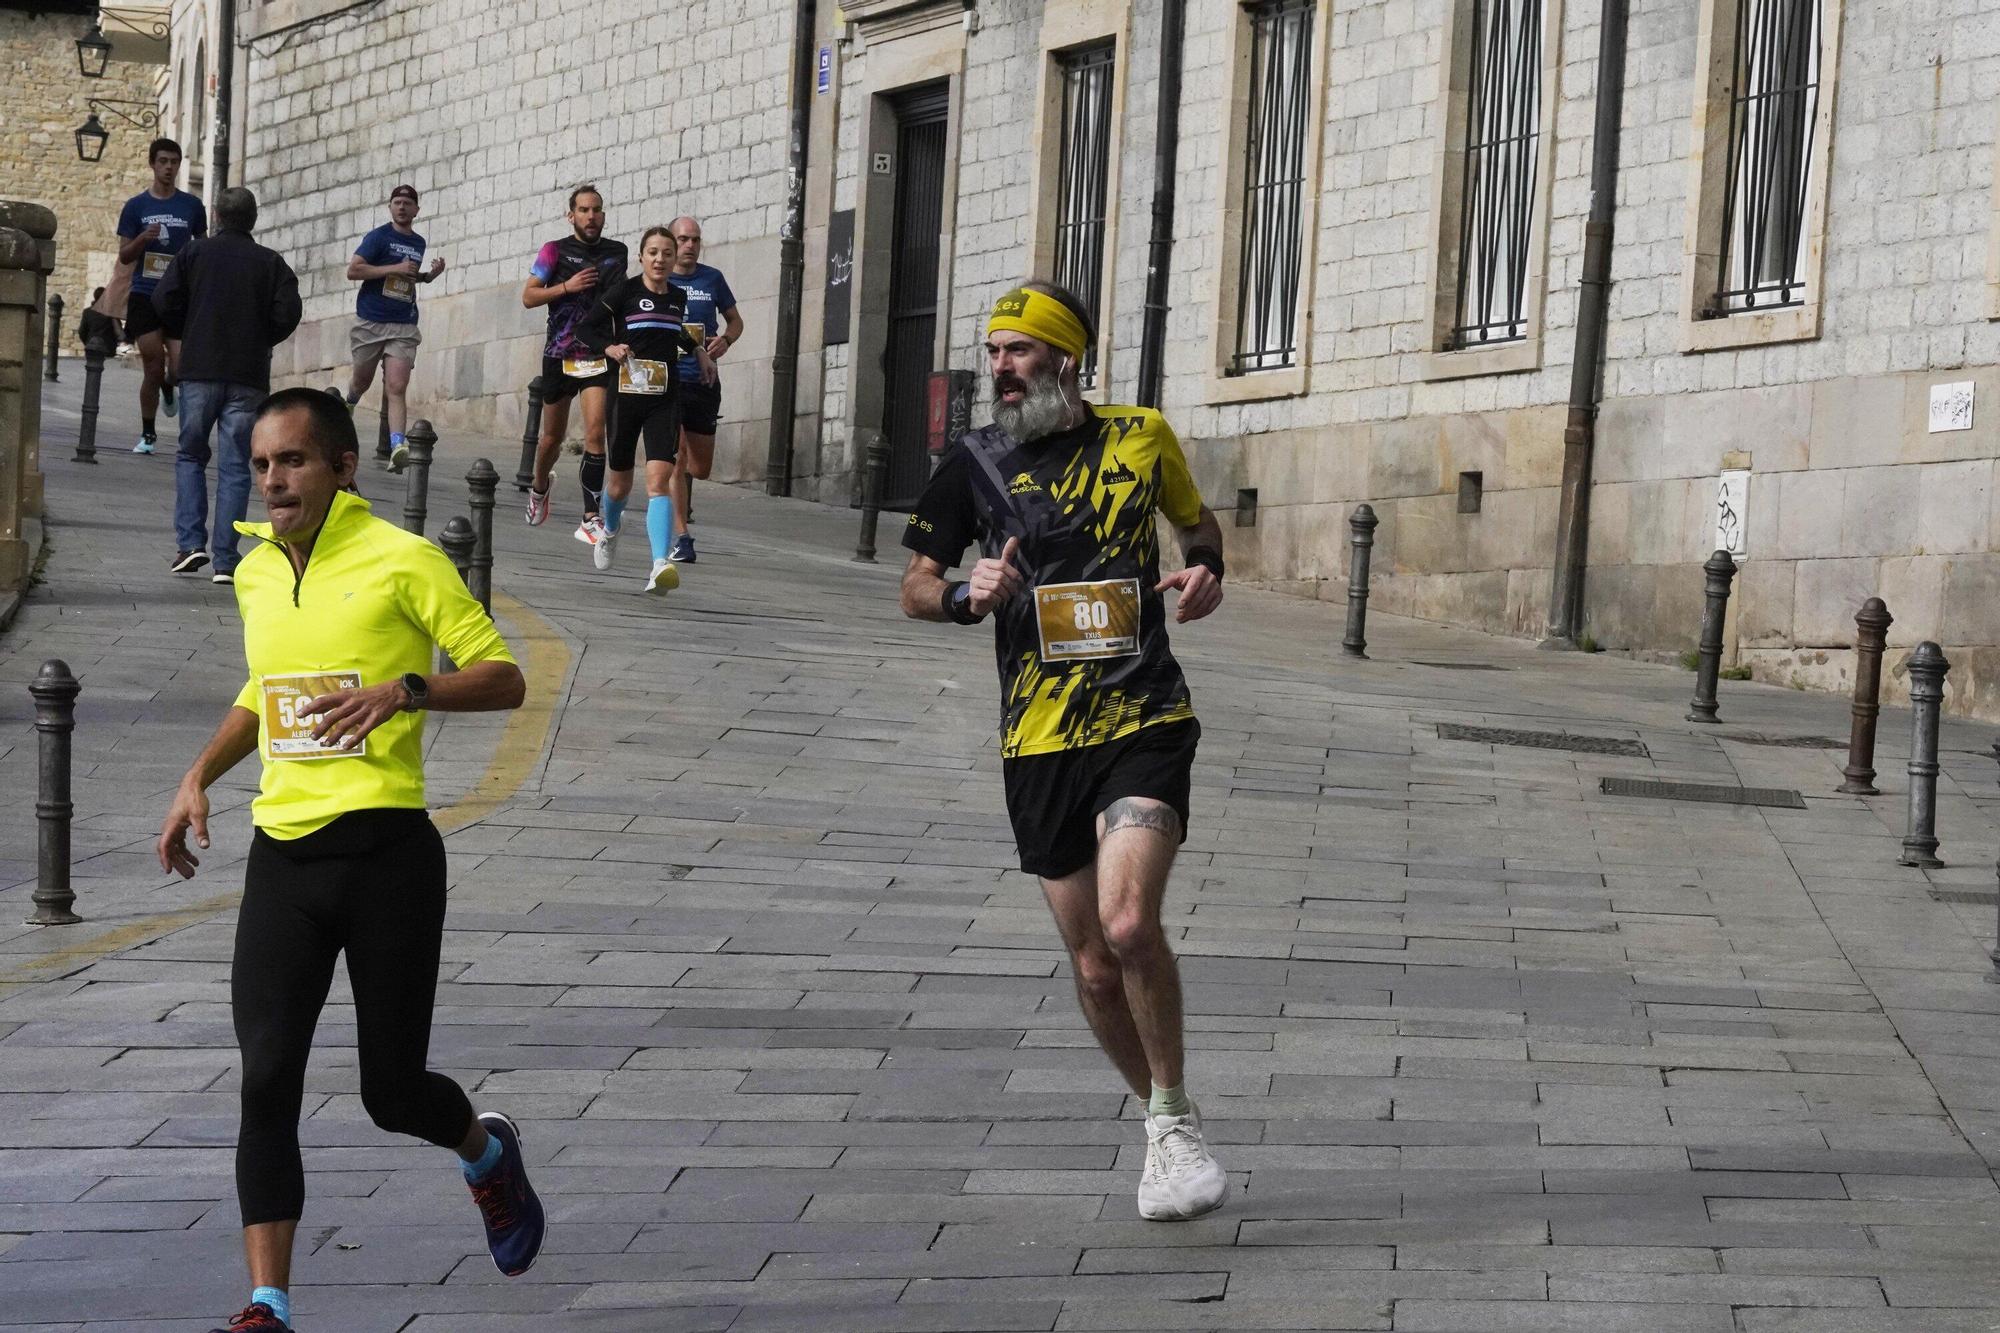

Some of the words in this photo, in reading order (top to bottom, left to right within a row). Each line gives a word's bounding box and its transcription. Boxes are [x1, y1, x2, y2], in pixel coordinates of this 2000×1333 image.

[1110, 475, 1129, 483] 42195
[1073, 600, 1108, 630] 80
[339, 679, 355, 689] 10K
